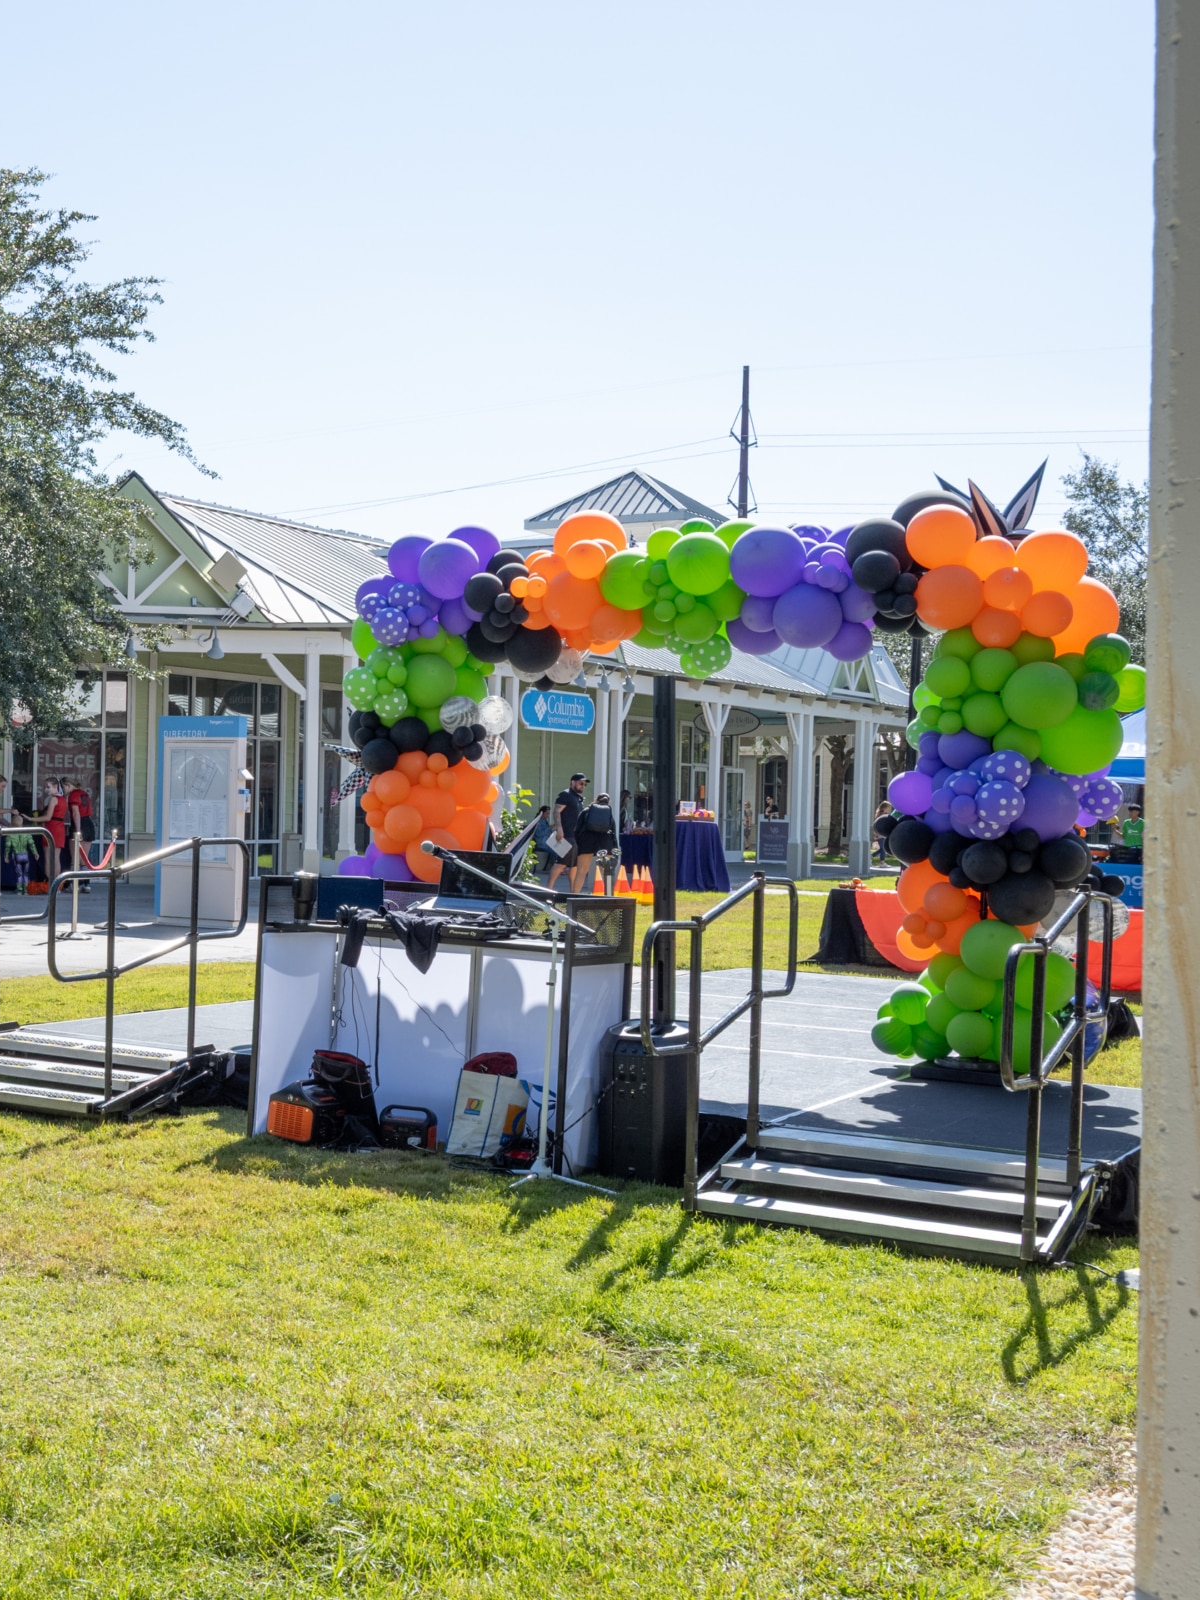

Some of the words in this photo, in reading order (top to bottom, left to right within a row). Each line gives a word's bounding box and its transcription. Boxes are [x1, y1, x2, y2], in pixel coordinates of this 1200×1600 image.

[547, 694, 585, 718] Columbia
[163, 730, 208, 738] DIRECTORY
[37, 753, 96, 769] FLEECE
